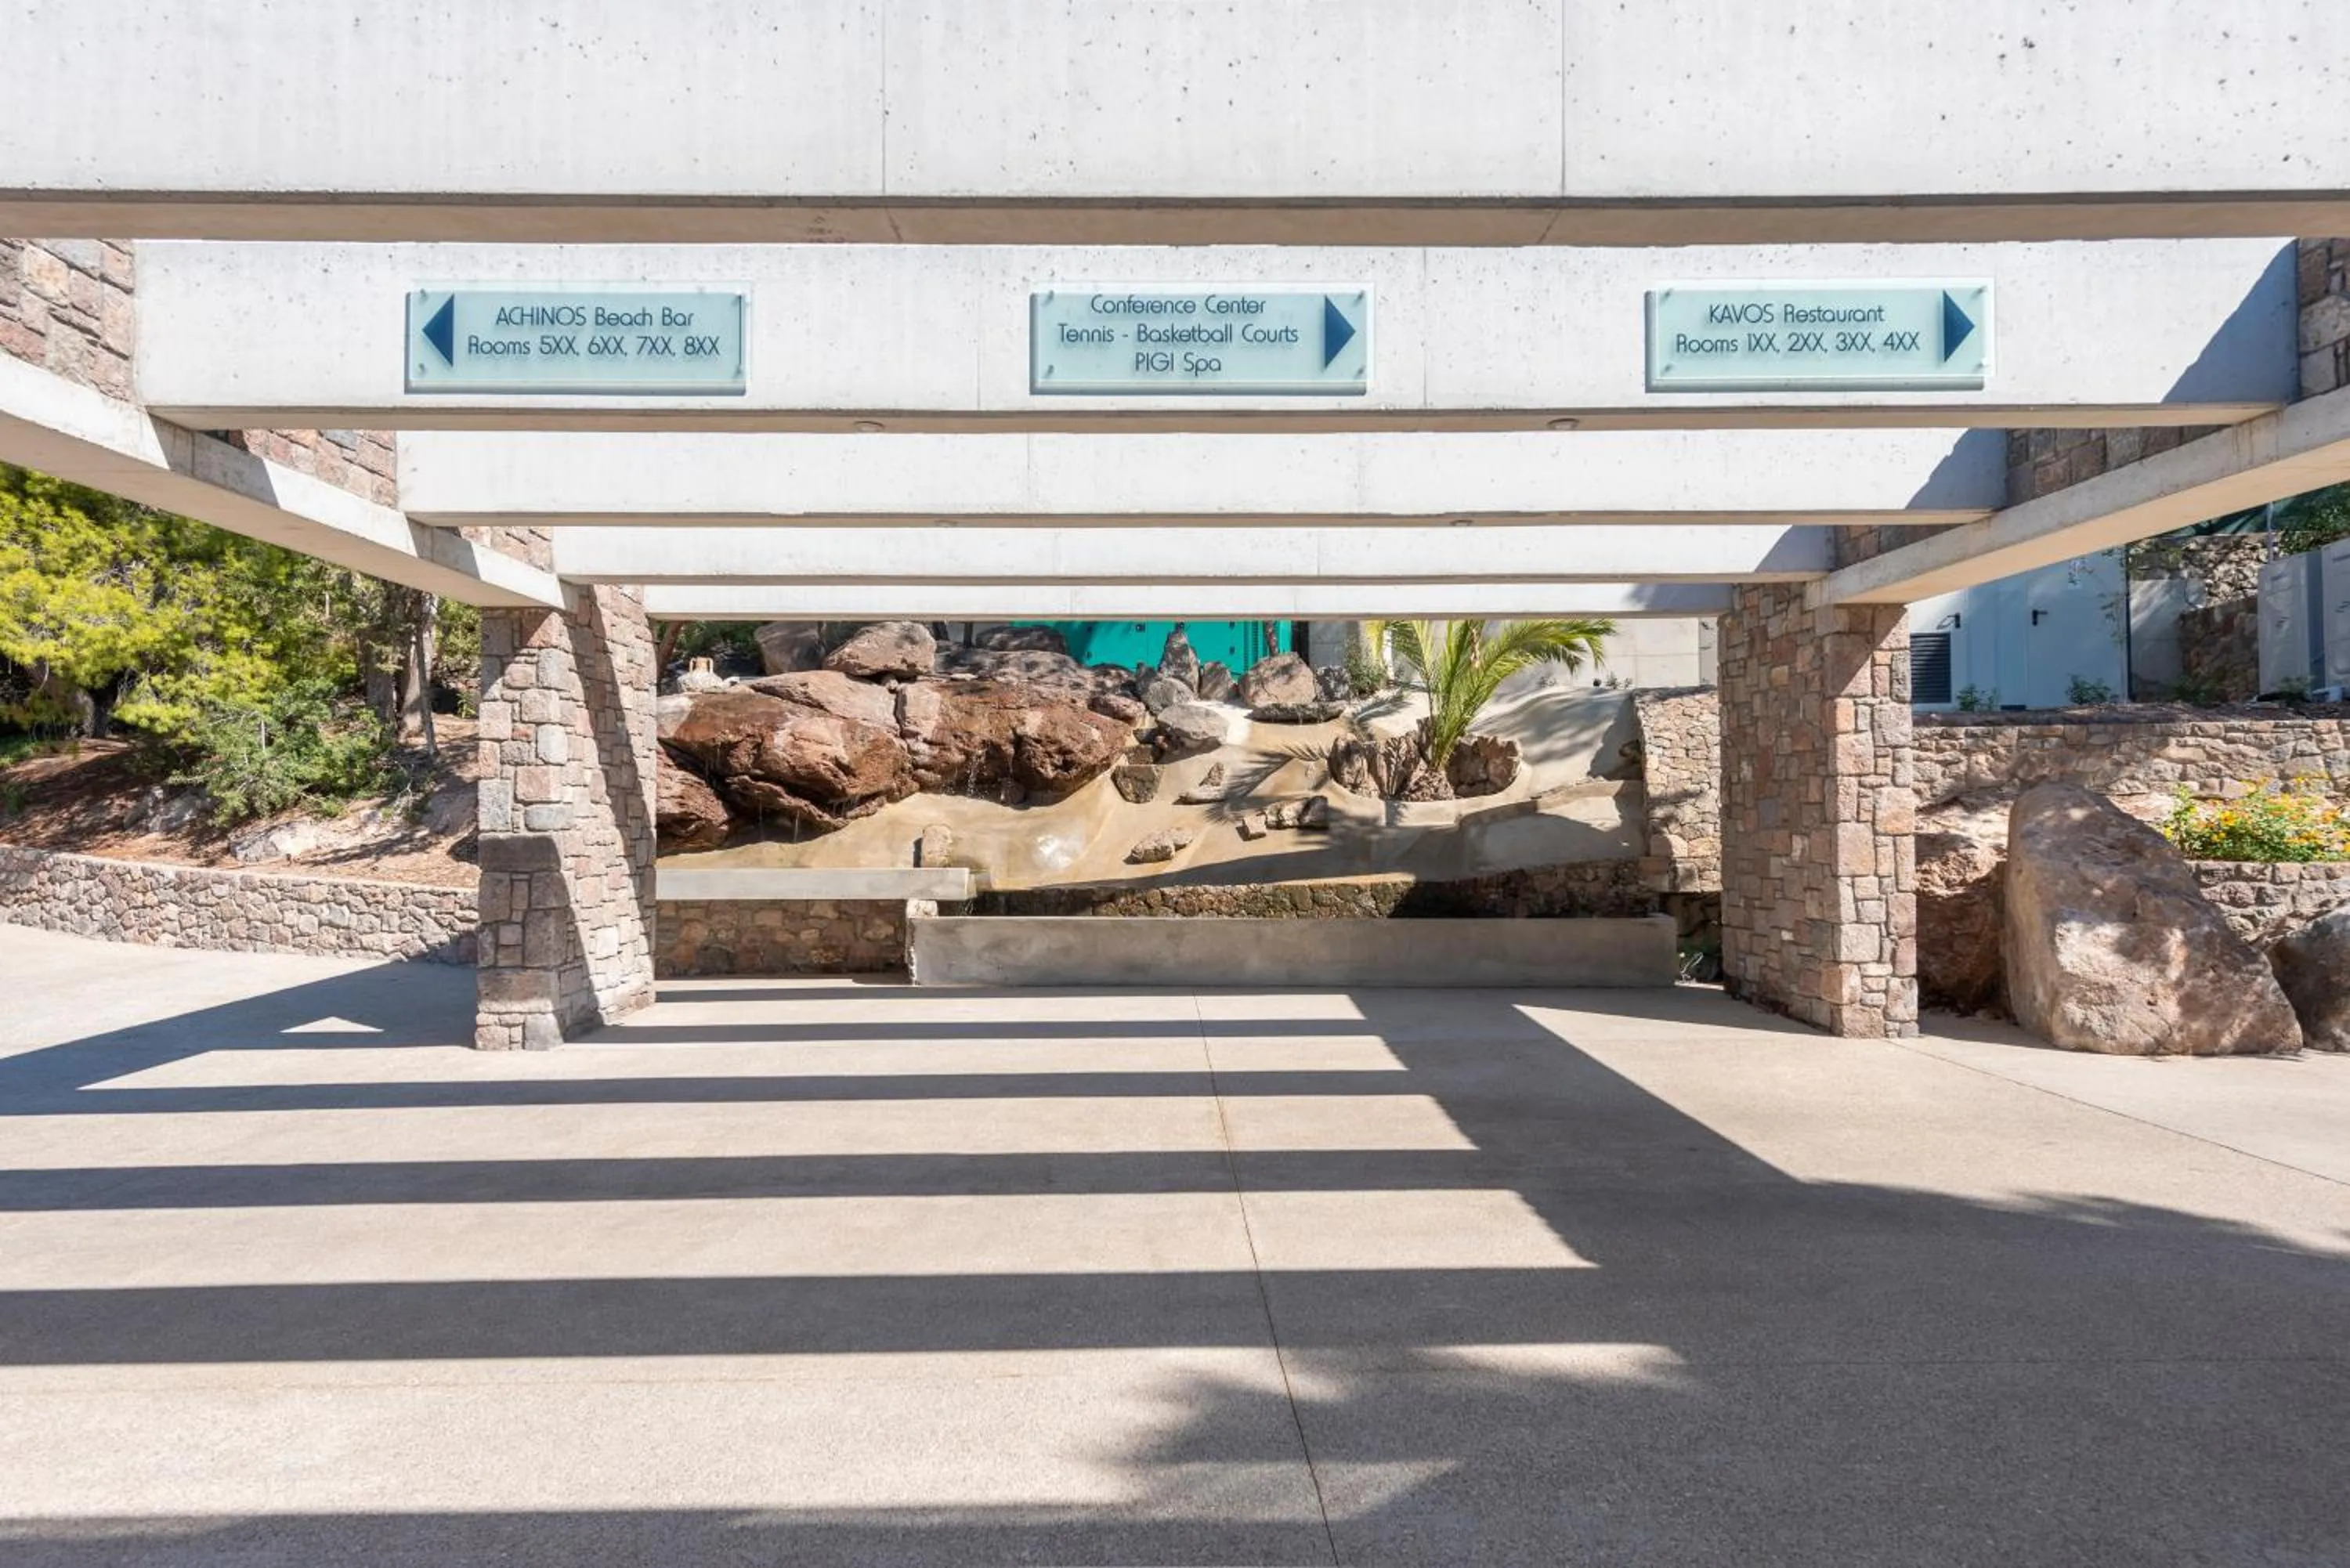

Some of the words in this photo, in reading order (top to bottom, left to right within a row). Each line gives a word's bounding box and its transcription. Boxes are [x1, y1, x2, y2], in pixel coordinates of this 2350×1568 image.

[1090, 294, 1195, 314] Conference
[1205, 294, 1266, 314] Center
[1708, 303, 1773, 323] KAVOS
[1784, 303, 1885, 323] Restaurant
[495, 306, 587, 327] ACHINOS
[595, 306, 653, 327] Beach
[662, 306, 694, 327] Bar
[1058, 323, 1115, 343] Tennis
[1137, 323, 1232, 343] Basketball
[1242, 323, 1298, 343] Courts
[1676, 333, 1737, 353] Rooms
[1788, 332, 1828, 353] 2XX,
[1835, 332, 1875, 353] 3XX,
[1883, 331, 1920, 352] 4XX
[468, 336, 531, 356] Rooms
[539, 336, 580, 356] 5XX,
[588, 336, 627, 356] 6XX,
[636, 336, 676, 356] 7XX,
[684, 336, 720, 356] 8XX
[1135, 352, 1174, 372] PIGI
[1184, 352, 1222, 377] Spa
